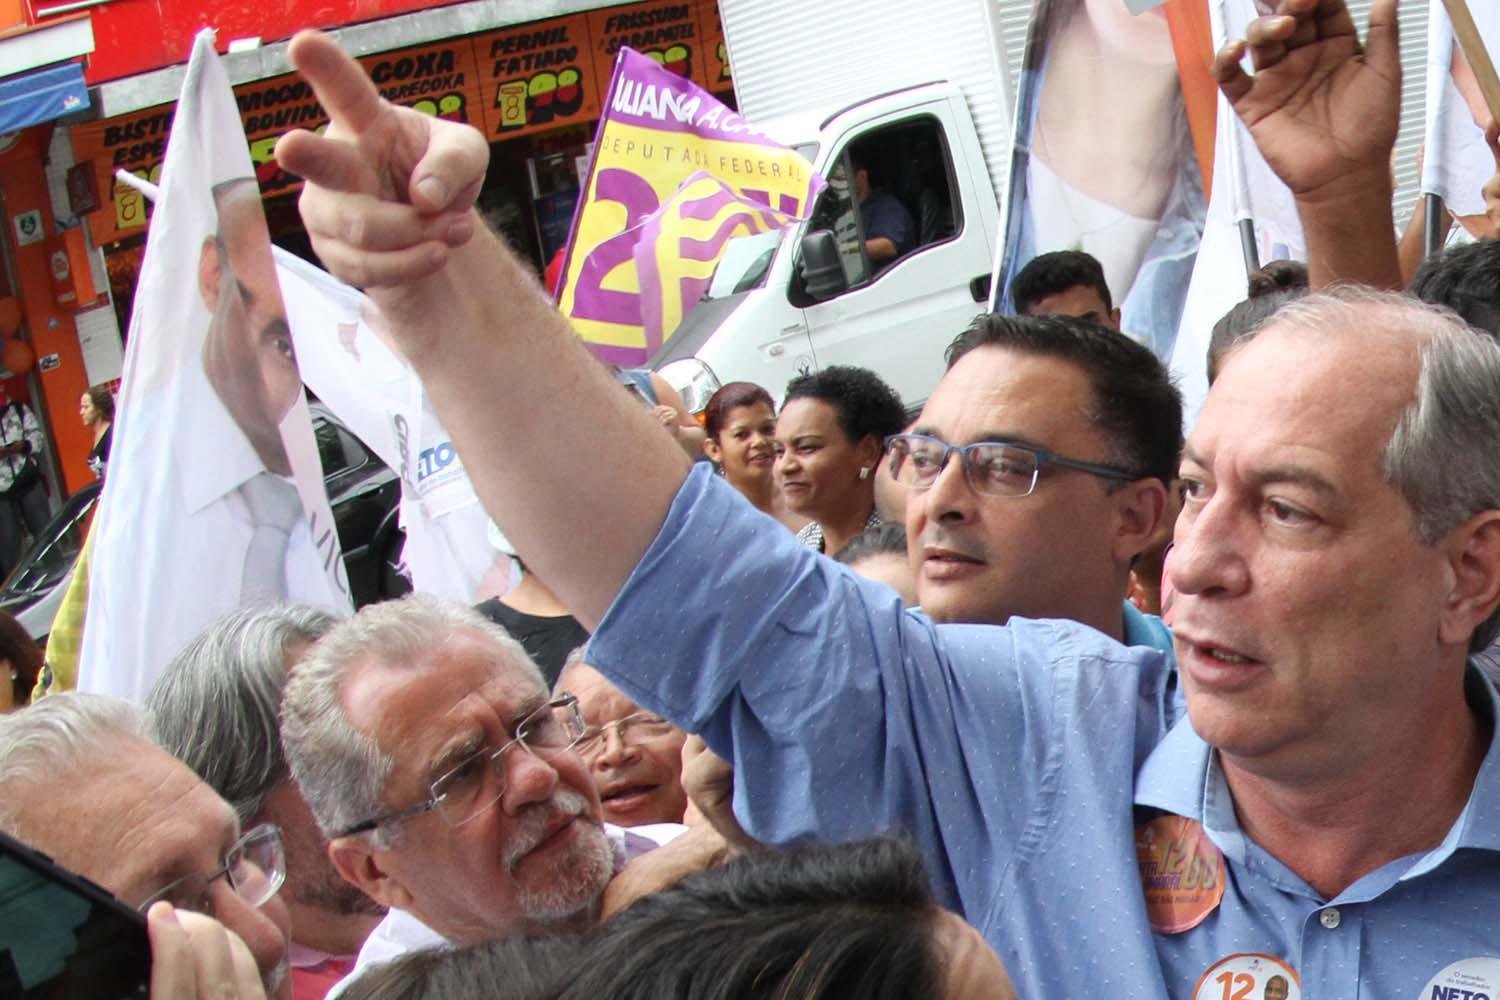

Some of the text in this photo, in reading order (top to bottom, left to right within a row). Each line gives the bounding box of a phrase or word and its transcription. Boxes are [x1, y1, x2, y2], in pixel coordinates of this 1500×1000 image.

[490, 26, 569, 58] PERNIL
[371, 49, 454, 82] COXA
[493, 46, 578, 77] FATIADO
